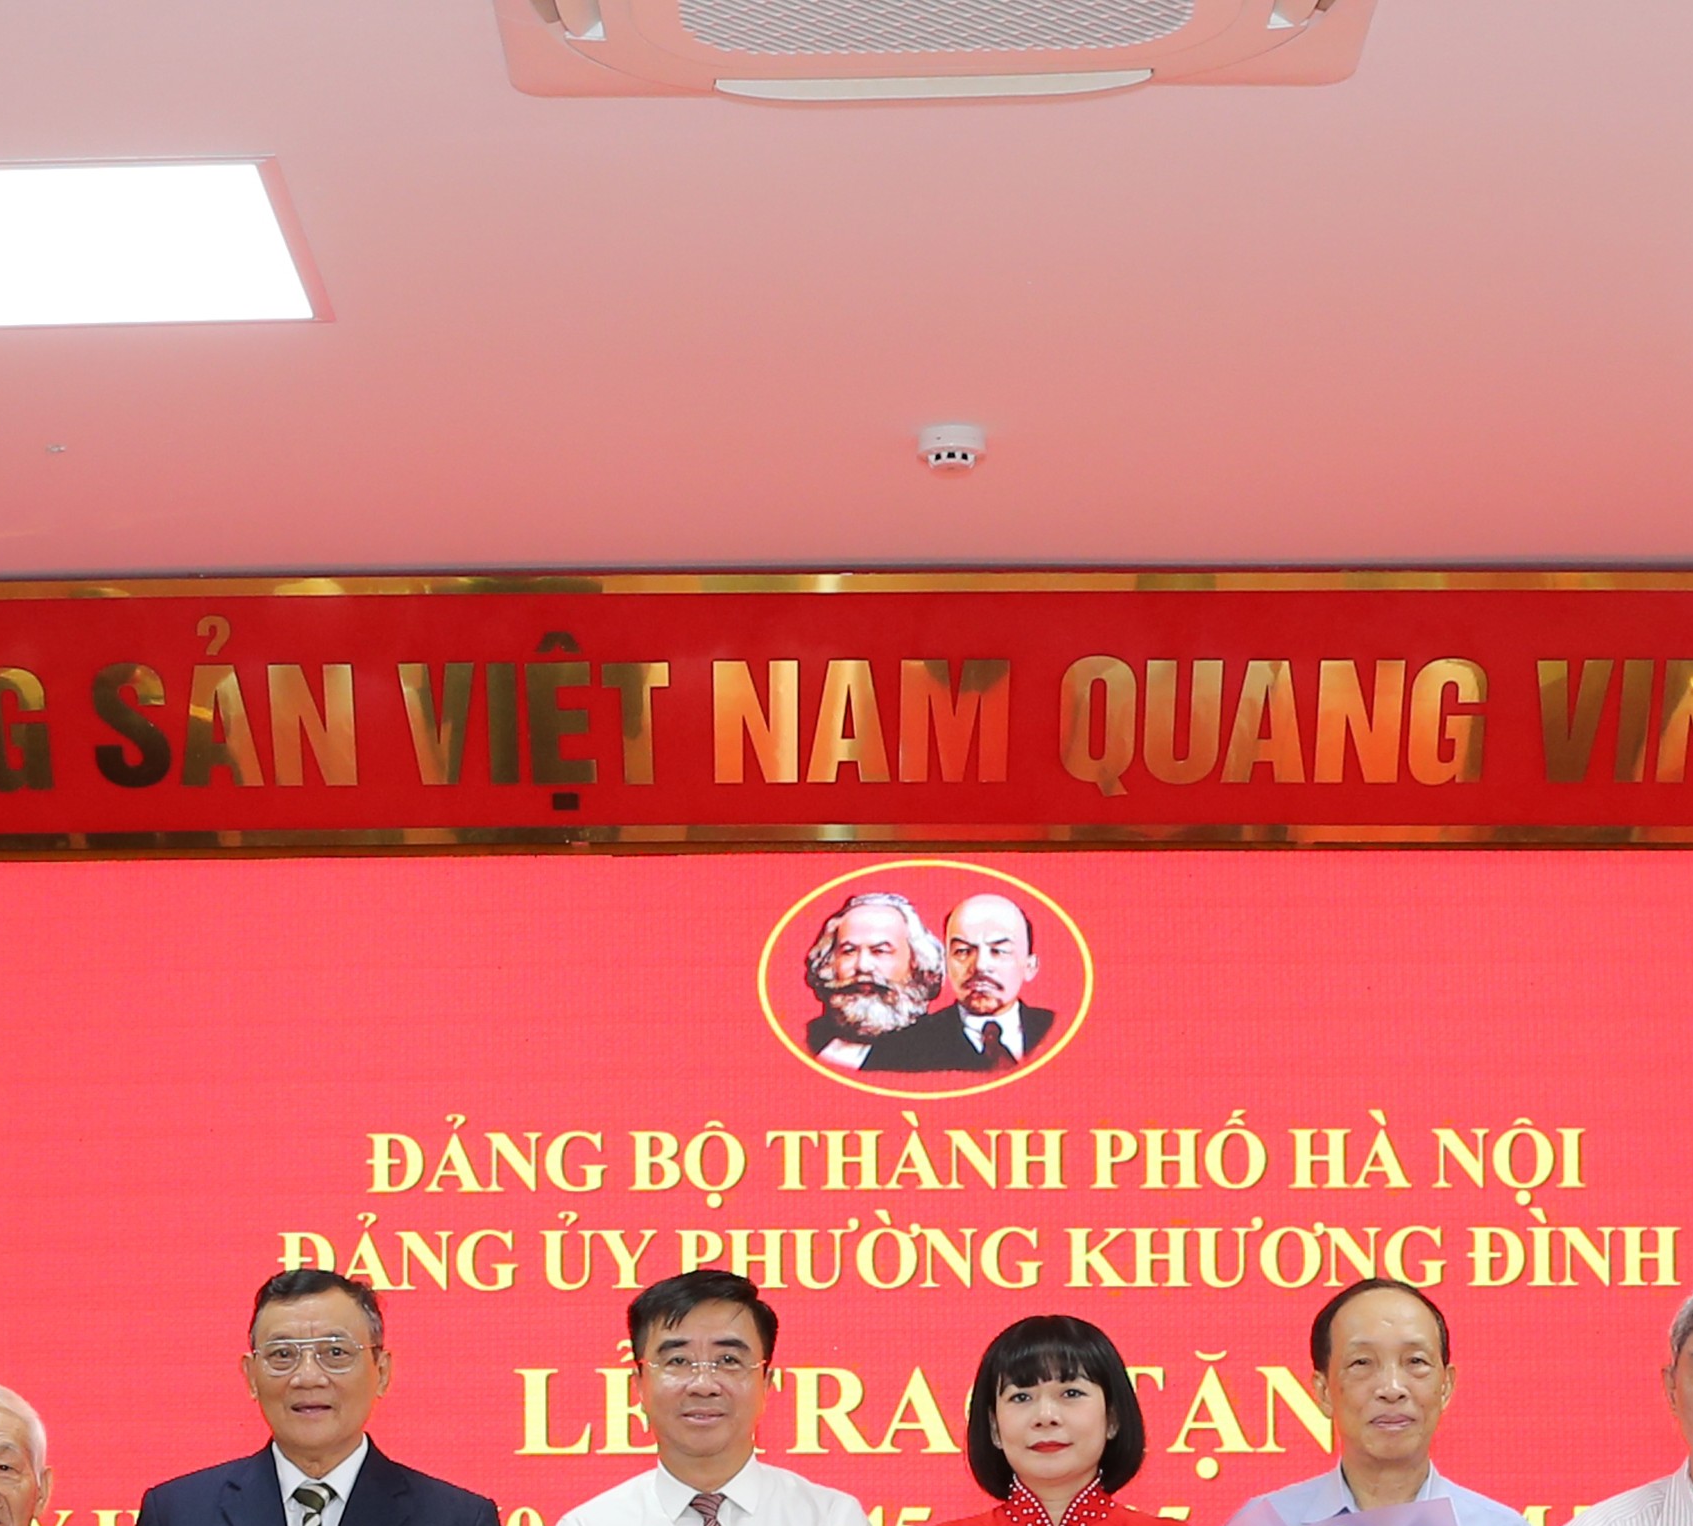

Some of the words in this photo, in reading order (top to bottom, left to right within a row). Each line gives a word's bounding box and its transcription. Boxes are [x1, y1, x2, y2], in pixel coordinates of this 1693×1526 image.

[92, 615, 358, 788] SẢN
[397, 631, 670, 811] VIỆT
[713, 659, 1011, 785] NAM
[1059, 654, 1489, 796] QUANG
[366, 1112, 609, 1193] ĐẢNG
[629, 1119, 746, 1209] BỘ
[765, 1110, 1069, 1191] THÀNH
[1089, 1108, 1268, 1190] PHỐ
[1288, 1108, 1413, 1190] HÀ
[1431, 1116, 1586, 1206] NỘI
[276, 1211, 520, 1292] ĐẢNG
[539, 1210, 658, 1292] ỦY
[674, 1208, 1044, 1290] PHƯỜNG
[1064, 1216, 1448, 1289] KHƯƠNG
[1466, 1206, 1682, 1288] ĐÌNH
[753, 1366, 974, 1454] RA
